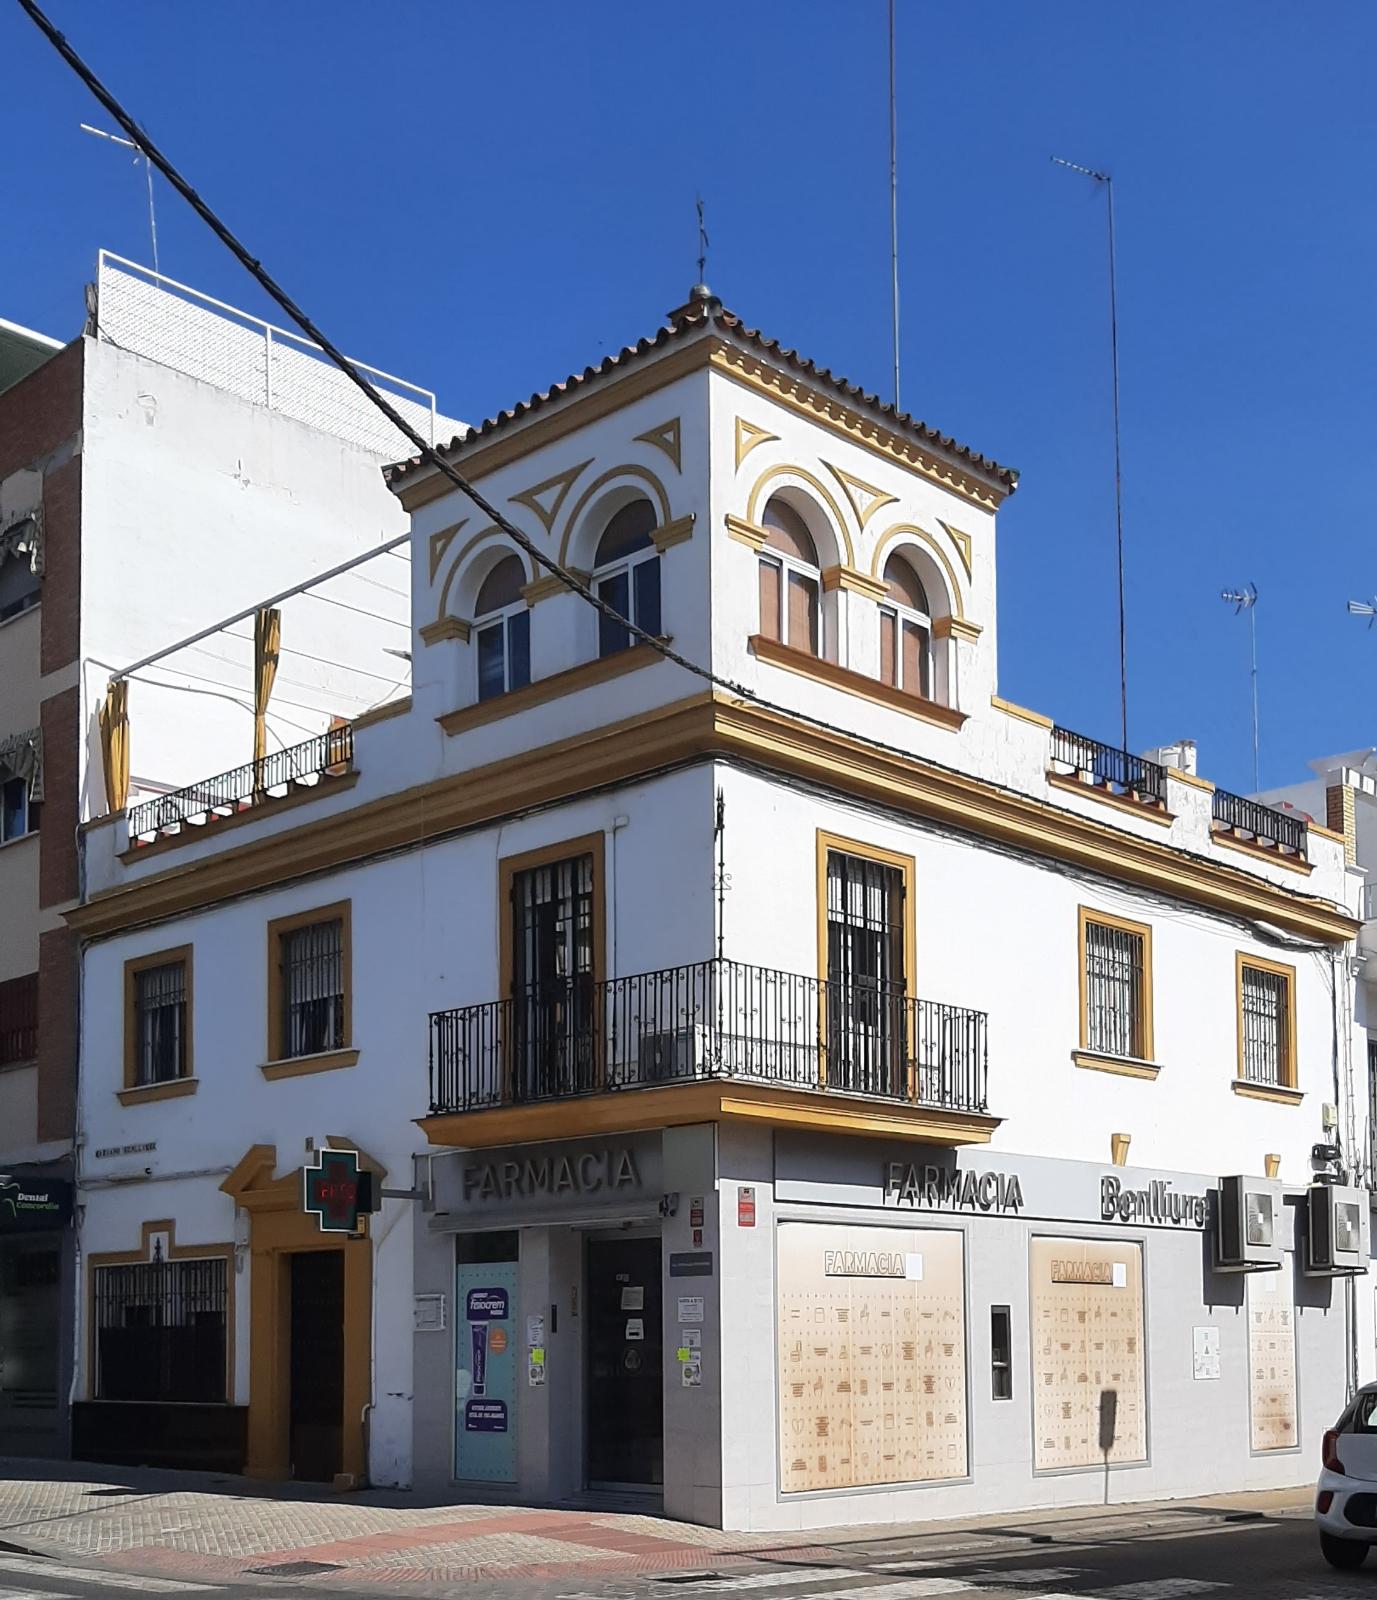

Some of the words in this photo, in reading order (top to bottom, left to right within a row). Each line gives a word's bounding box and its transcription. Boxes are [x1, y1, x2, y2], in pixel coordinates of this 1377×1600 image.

[461, 1149, 641, 1200] FARMACIA
[885, 1161, 1025, 1209] FARMACIA
[17, 1192, 49, 1202] Dental
[1101, 1175, 1209, 1223] Benlliure
[824, 1250, 905, 1275] FARMACIA
[1051, 1260, 1114, 1283] FARMACIA
